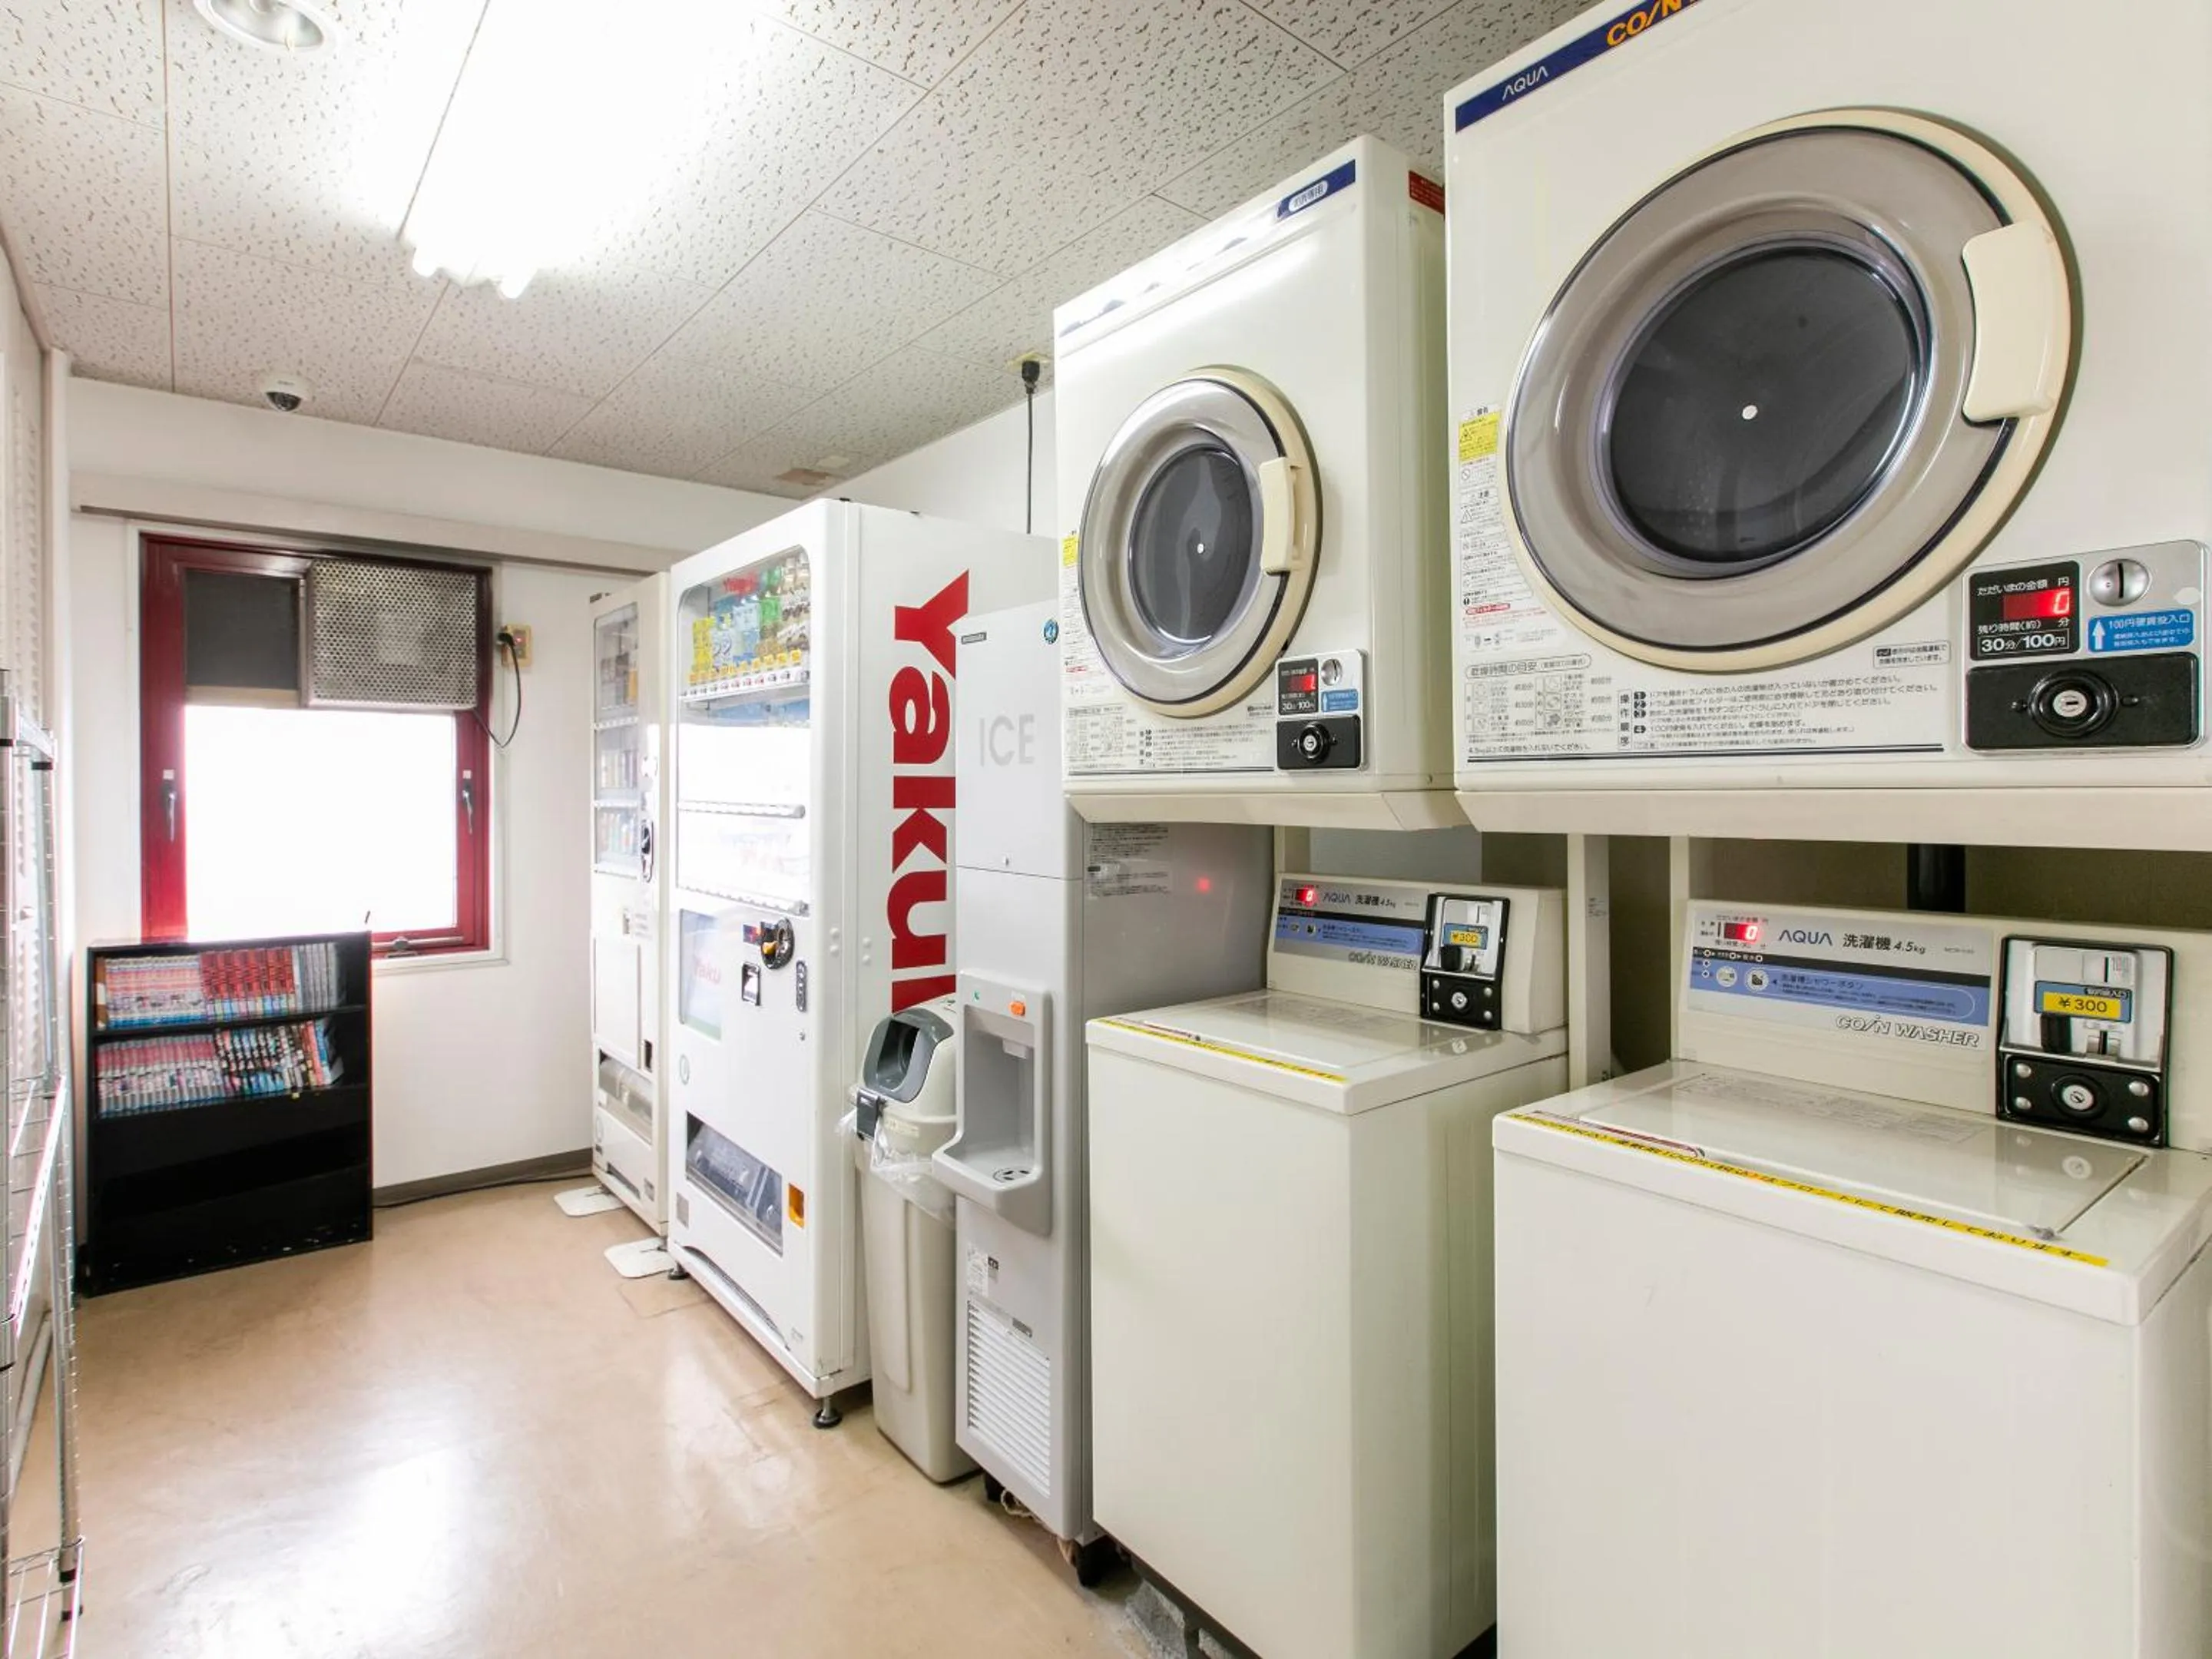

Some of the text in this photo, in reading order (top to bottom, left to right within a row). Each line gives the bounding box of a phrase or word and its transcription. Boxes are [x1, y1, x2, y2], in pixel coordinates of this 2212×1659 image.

[1502, 66, 1548, 101] AQUA
[979, 714, 1035, 767] ICE
[1323, 892, 1351, 905] AQUA
[1745, 925, 1758, 940] 0
[1778, 929, 1833, 946] AQUA
[1843, 933, 1926, 955] 洗濯機 4.5kg
[1894, 1022, 1980, 1047] WASHER
